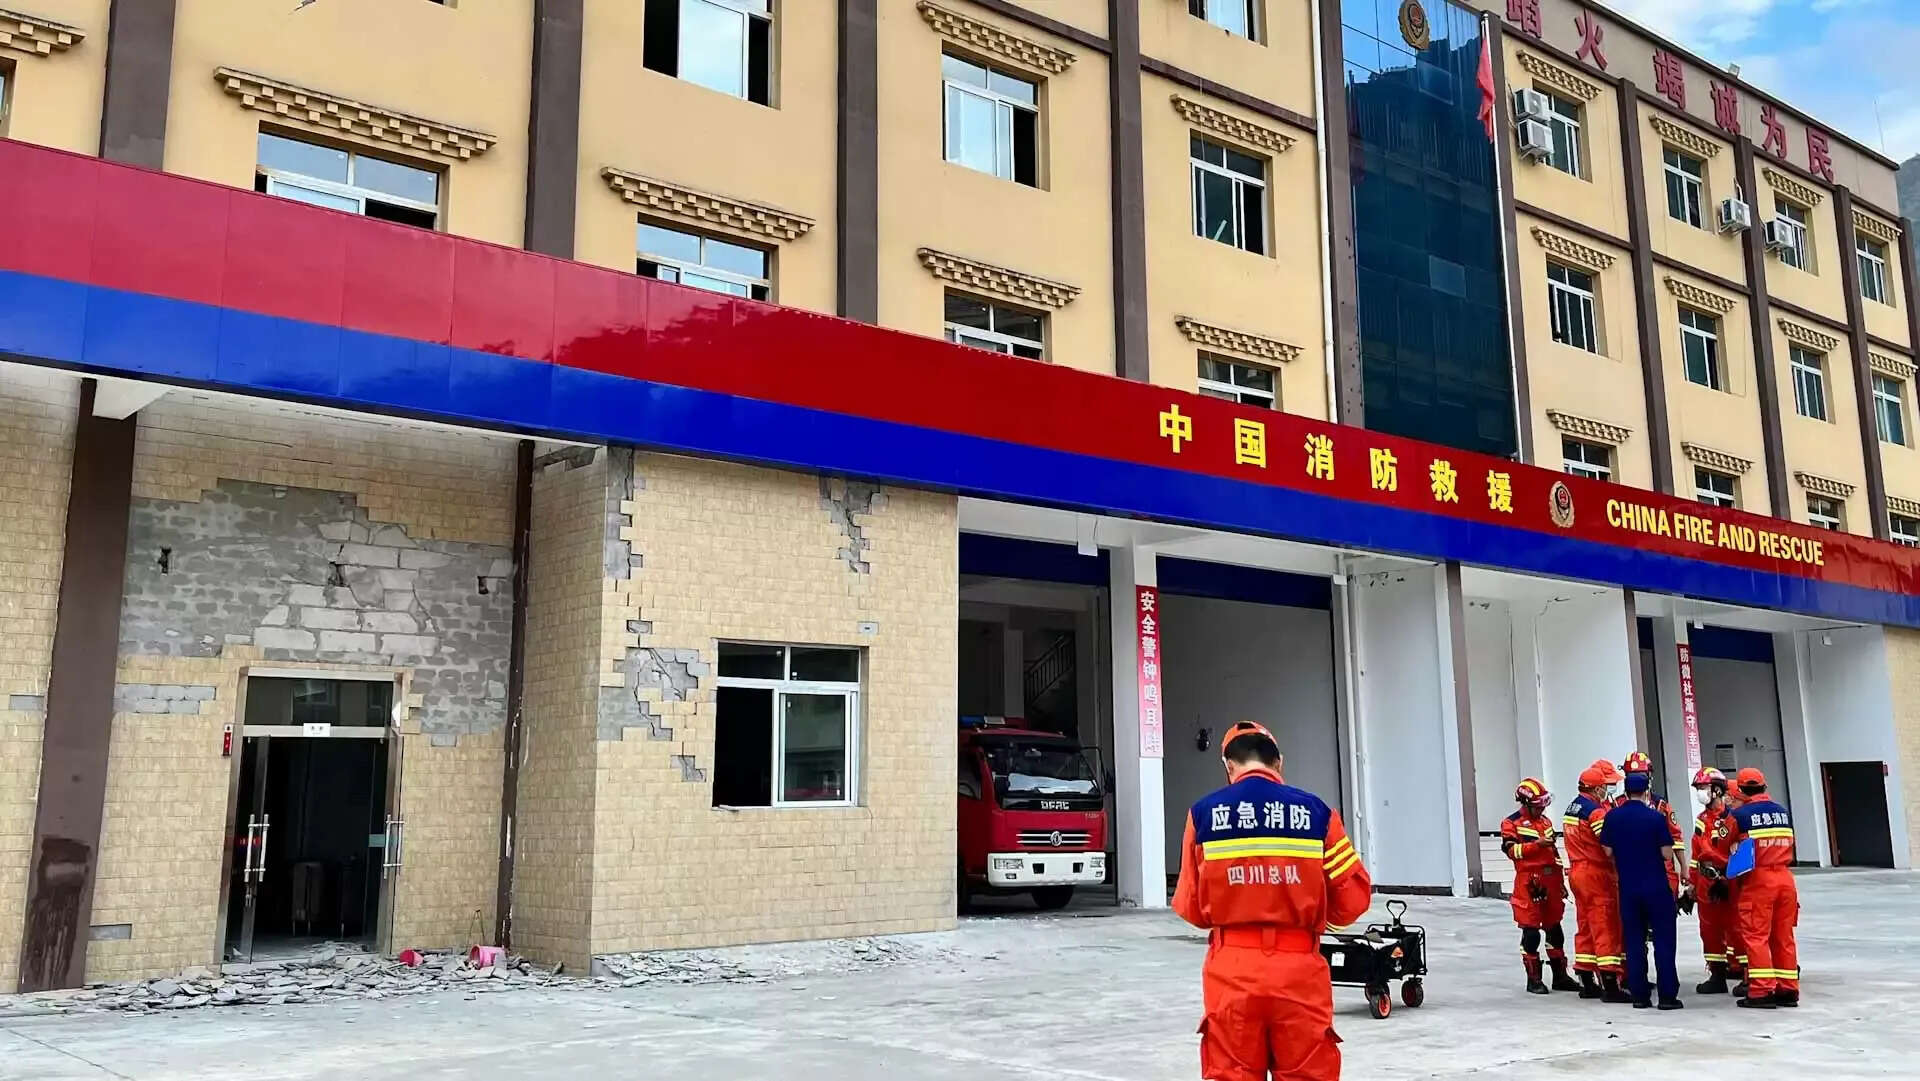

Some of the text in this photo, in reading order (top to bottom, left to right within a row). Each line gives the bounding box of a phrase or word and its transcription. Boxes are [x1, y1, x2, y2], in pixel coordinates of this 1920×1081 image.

[1653, 48, 1834, 184] 竭诚为民
[1159, 404, 1513, 513] 中国消防救援
[1606, 499, 1825, 566] CHINA FIRE AND RESCUE
[1211, 801, 1311, 831] 应急消防
[1227, 864, 1301, 886] 四川总队
